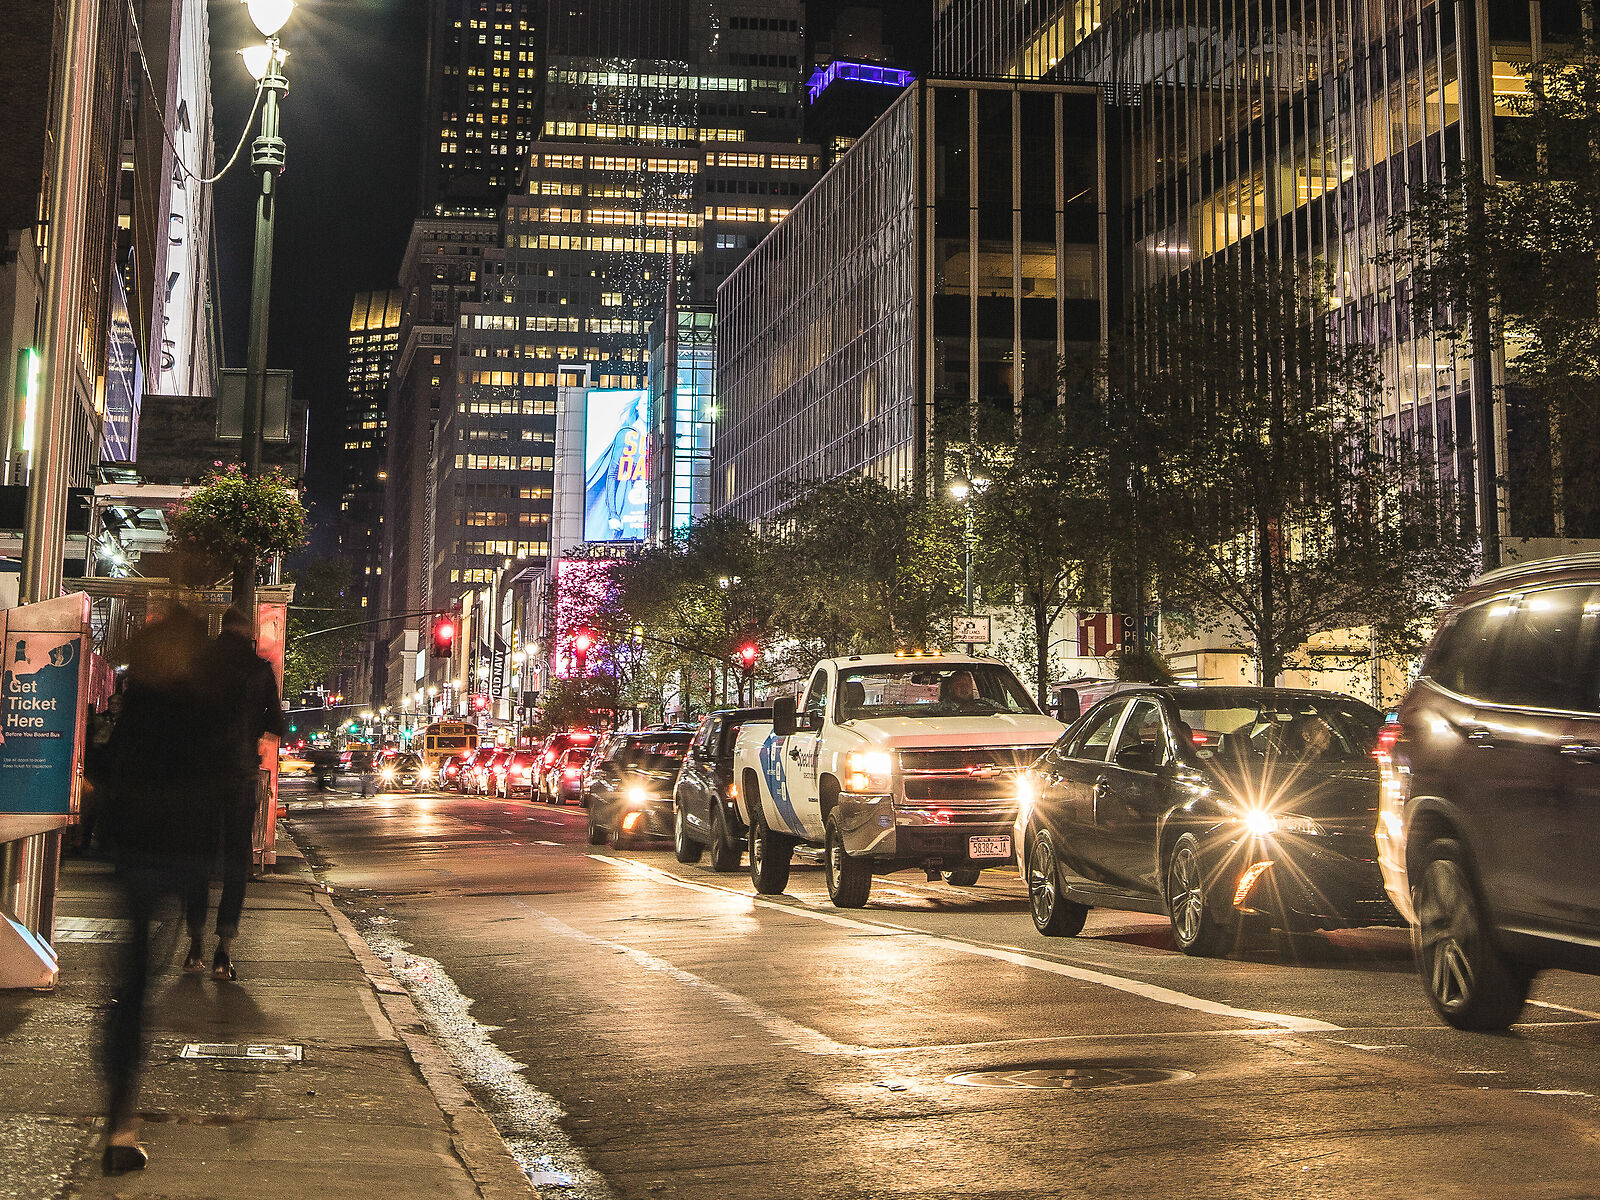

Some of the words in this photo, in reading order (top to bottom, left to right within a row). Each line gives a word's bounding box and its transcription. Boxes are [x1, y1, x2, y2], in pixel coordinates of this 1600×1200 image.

[493, 649, 504, 677] NAVY
[9, 680, 38, 693] Get
[492, 677, 503, 695] OLD
[8, 696, 57, 711] Ticket
[6, 713, 44, 728] Here
